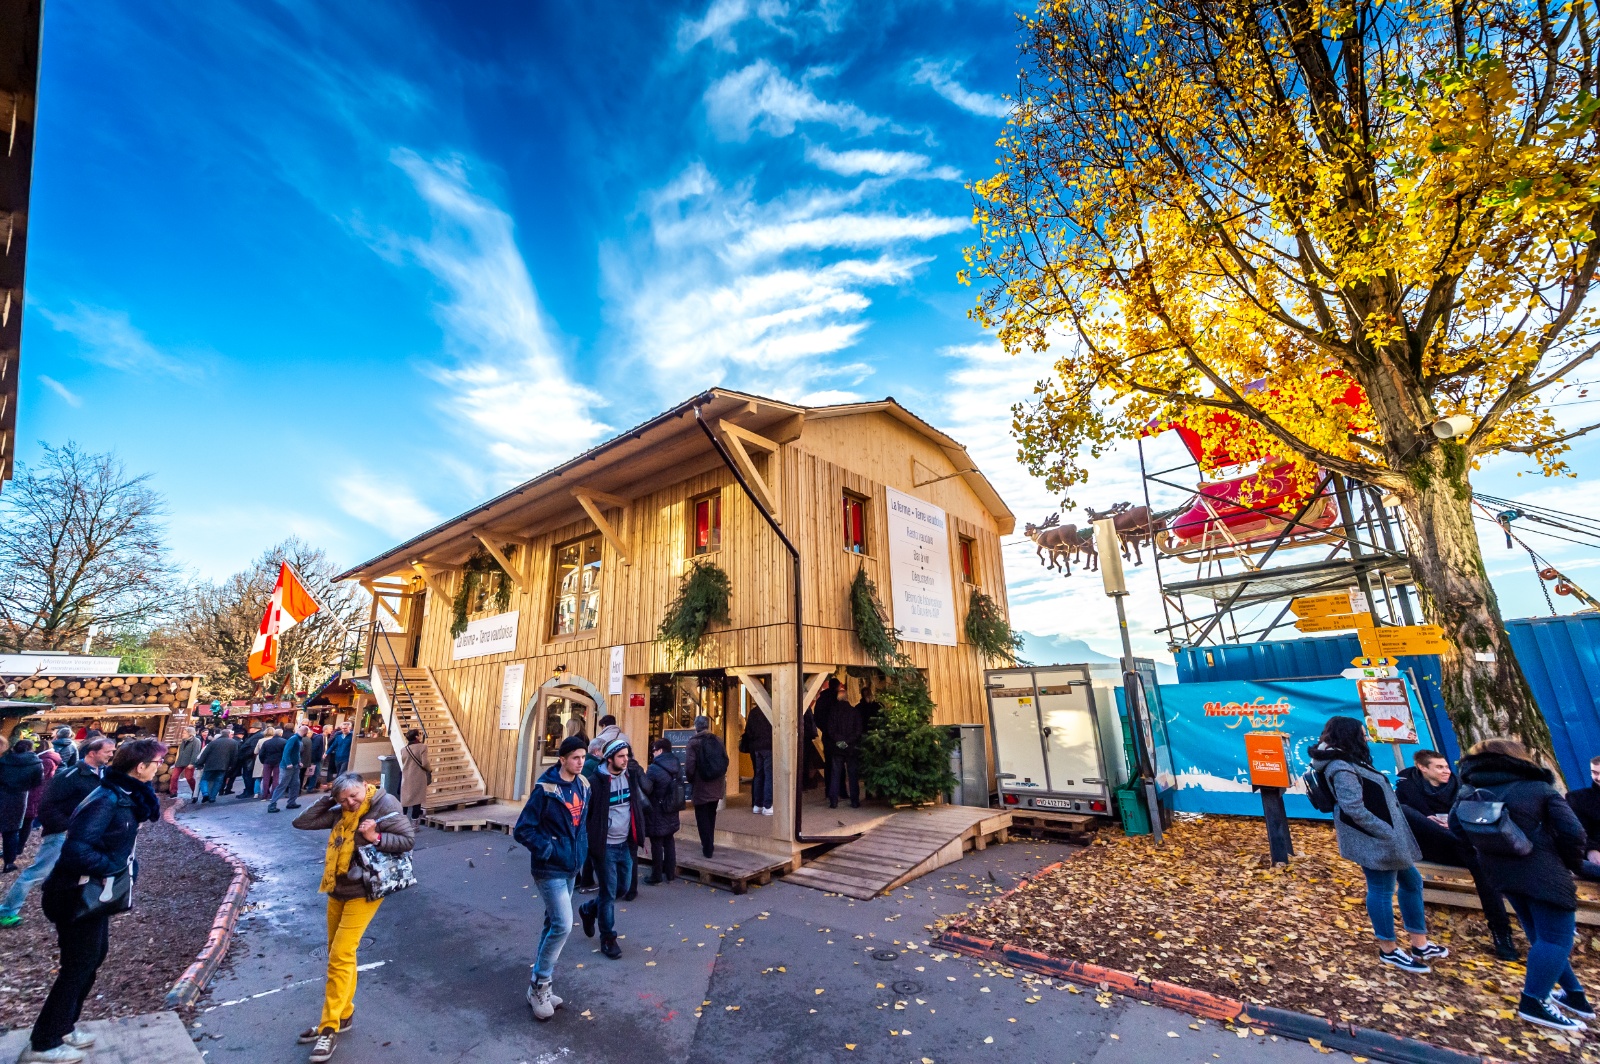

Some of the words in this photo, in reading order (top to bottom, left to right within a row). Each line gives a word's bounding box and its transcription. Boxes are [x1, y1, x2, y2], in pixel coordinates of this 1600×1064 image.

[891, 498, 897, 510] La
[897, 501, 911, 516] ferme
[915, 508, 926, 522] Terre
[1203, 702, 1290, 716] Montreux
